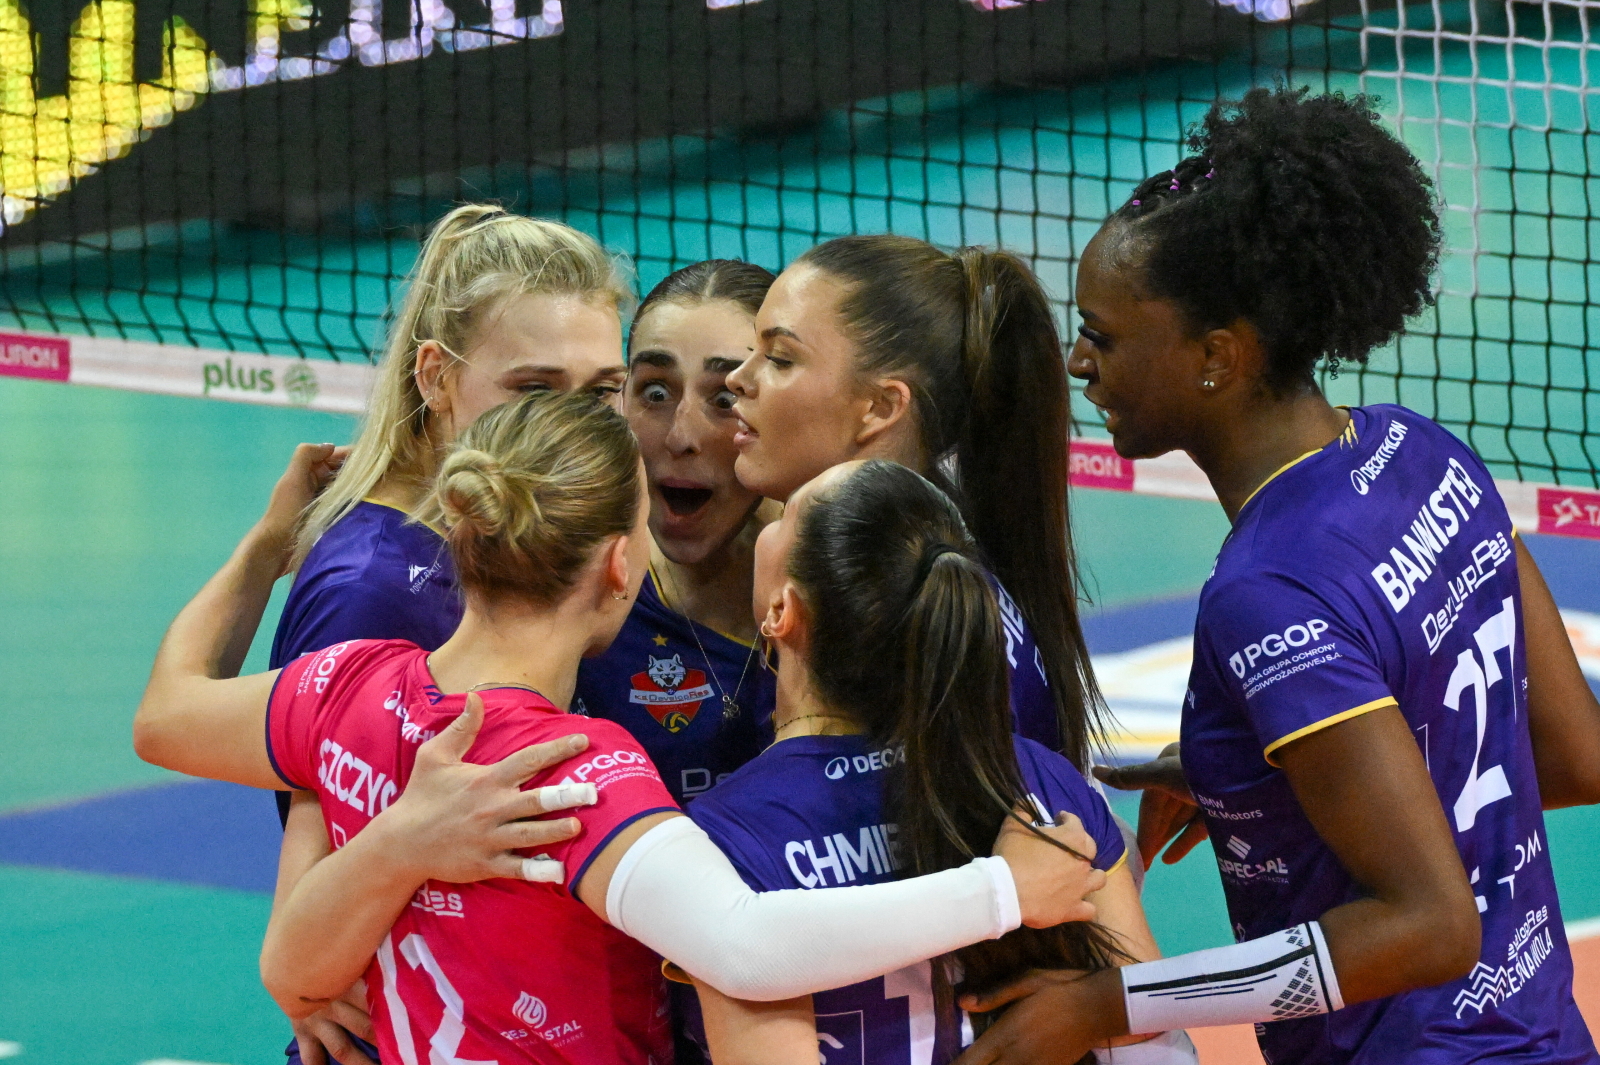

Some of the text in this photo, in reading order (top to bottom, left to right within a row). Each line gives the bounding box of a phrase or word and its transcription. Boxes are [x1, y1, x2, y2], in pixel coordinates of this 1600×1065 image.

[203, 355, 275, 396] plus
[1359, 420, 1408, 481] DECATHLON
[1371, 457, 1483, 614] BANNISTER
[313, 640, 354, 694] GOP
[1242, 642, 1336, 690] OLSKA GRUPA OCHRONY
[1243, 618, 1329, 669] PGOP
[1219, 809, 1263, 821] Motors
